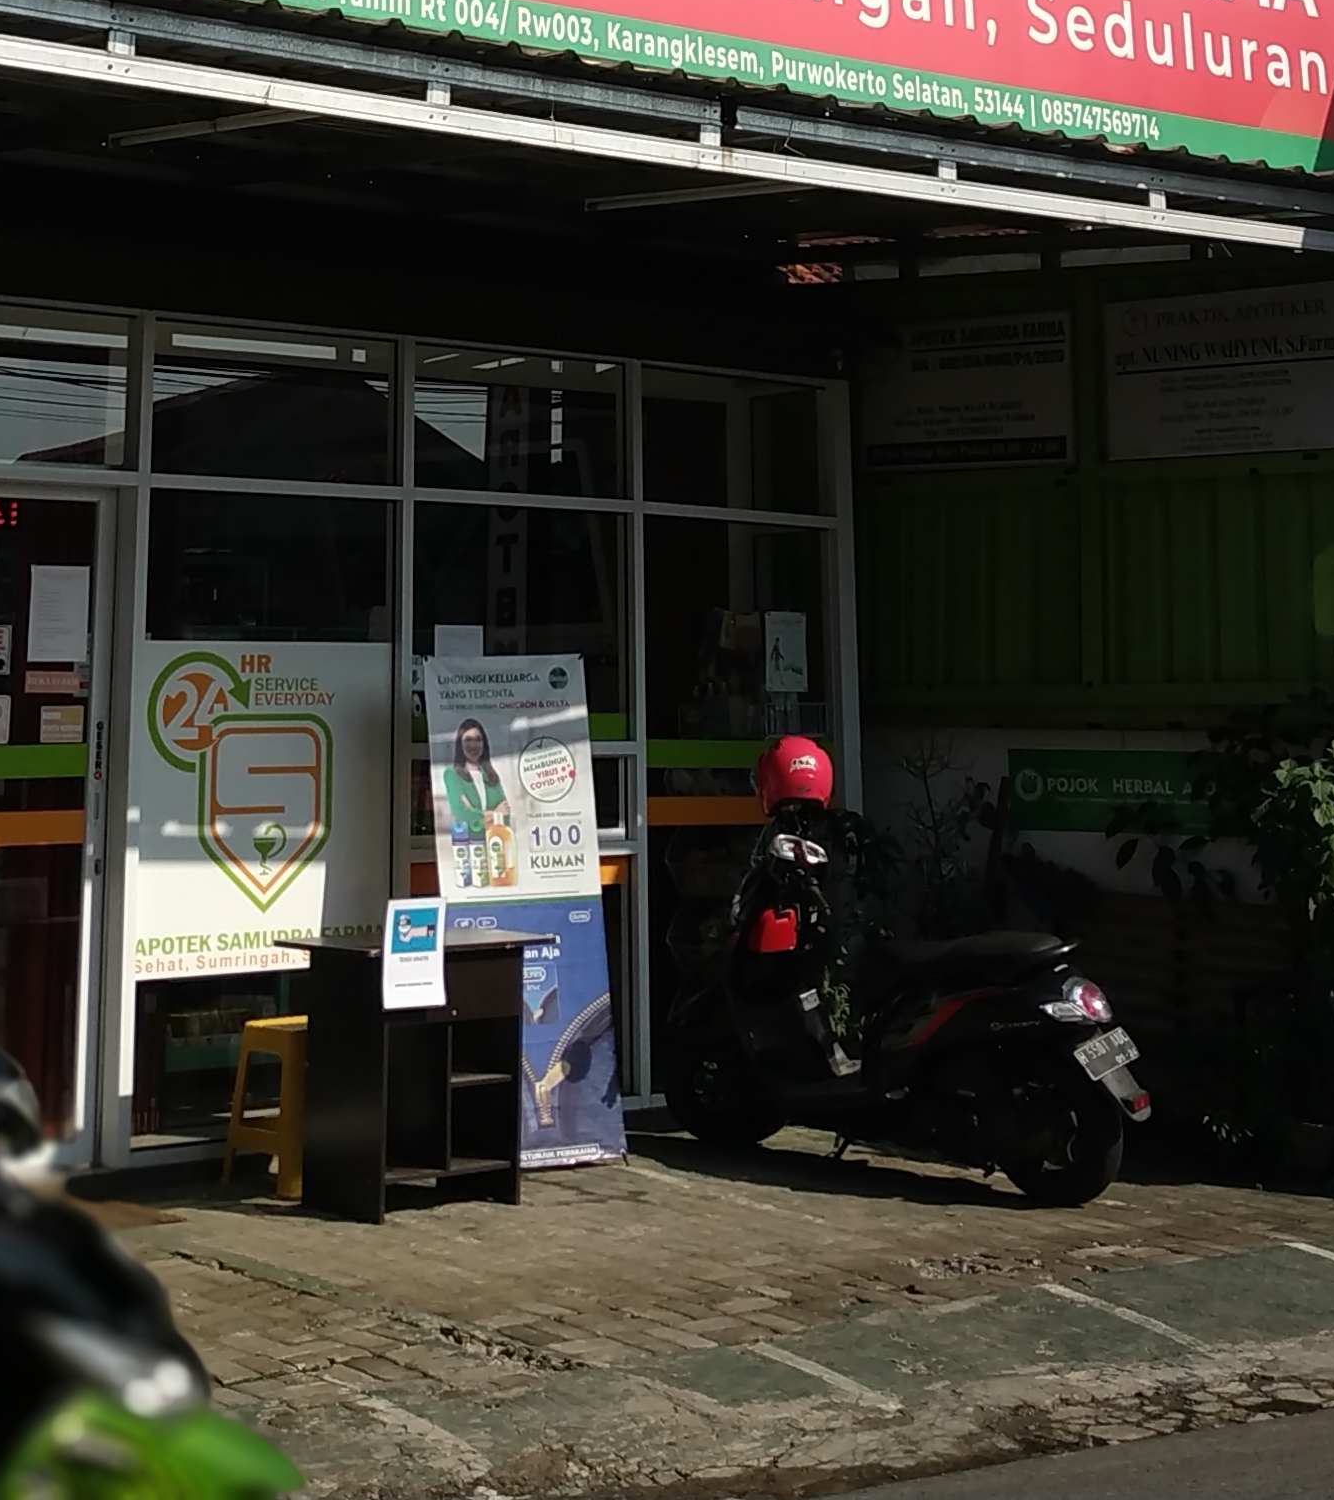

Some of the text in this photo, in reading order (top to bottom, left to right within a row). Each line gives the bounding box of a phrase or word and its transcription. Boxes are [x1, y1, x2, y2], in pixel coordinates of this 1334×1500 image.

[517, 6, 600, 52] Rw003,
[606, 21, 765, 77] Karangklesem,
[771, 49, 887, 98] Purwokerto
[892, 71, 969, 115] Selatan,
[973, 86, 1025, 120] 53144
[1041, 99, 1161, 142] 085747569714
[1156, 299, 1326, 329] PRAKTIK APOTEKER
[1023, 320, 1065, 338] FARMA
[240, 654, 272, 674] HR
[254, 677, 319, 691] SERVICE
[437, 672, 540, 685] LINDUNGI KELUARGA
[254, 692, 336, 706] EVERYDAY
[439, 688, 515, 699] YANG TERCINTA
[536, 768, 559, 779] VIRUS
[1047, 777, 1098, 794] POJOK
[1113, 778, 1174, 795] HERBAL
[530, 853, 585, 869] KUMAN
[135, 934, 213, 956] APOTEK
[135, 954, 190, 974] Sehat,
[195, 949, 297, 971] Sumringah,
